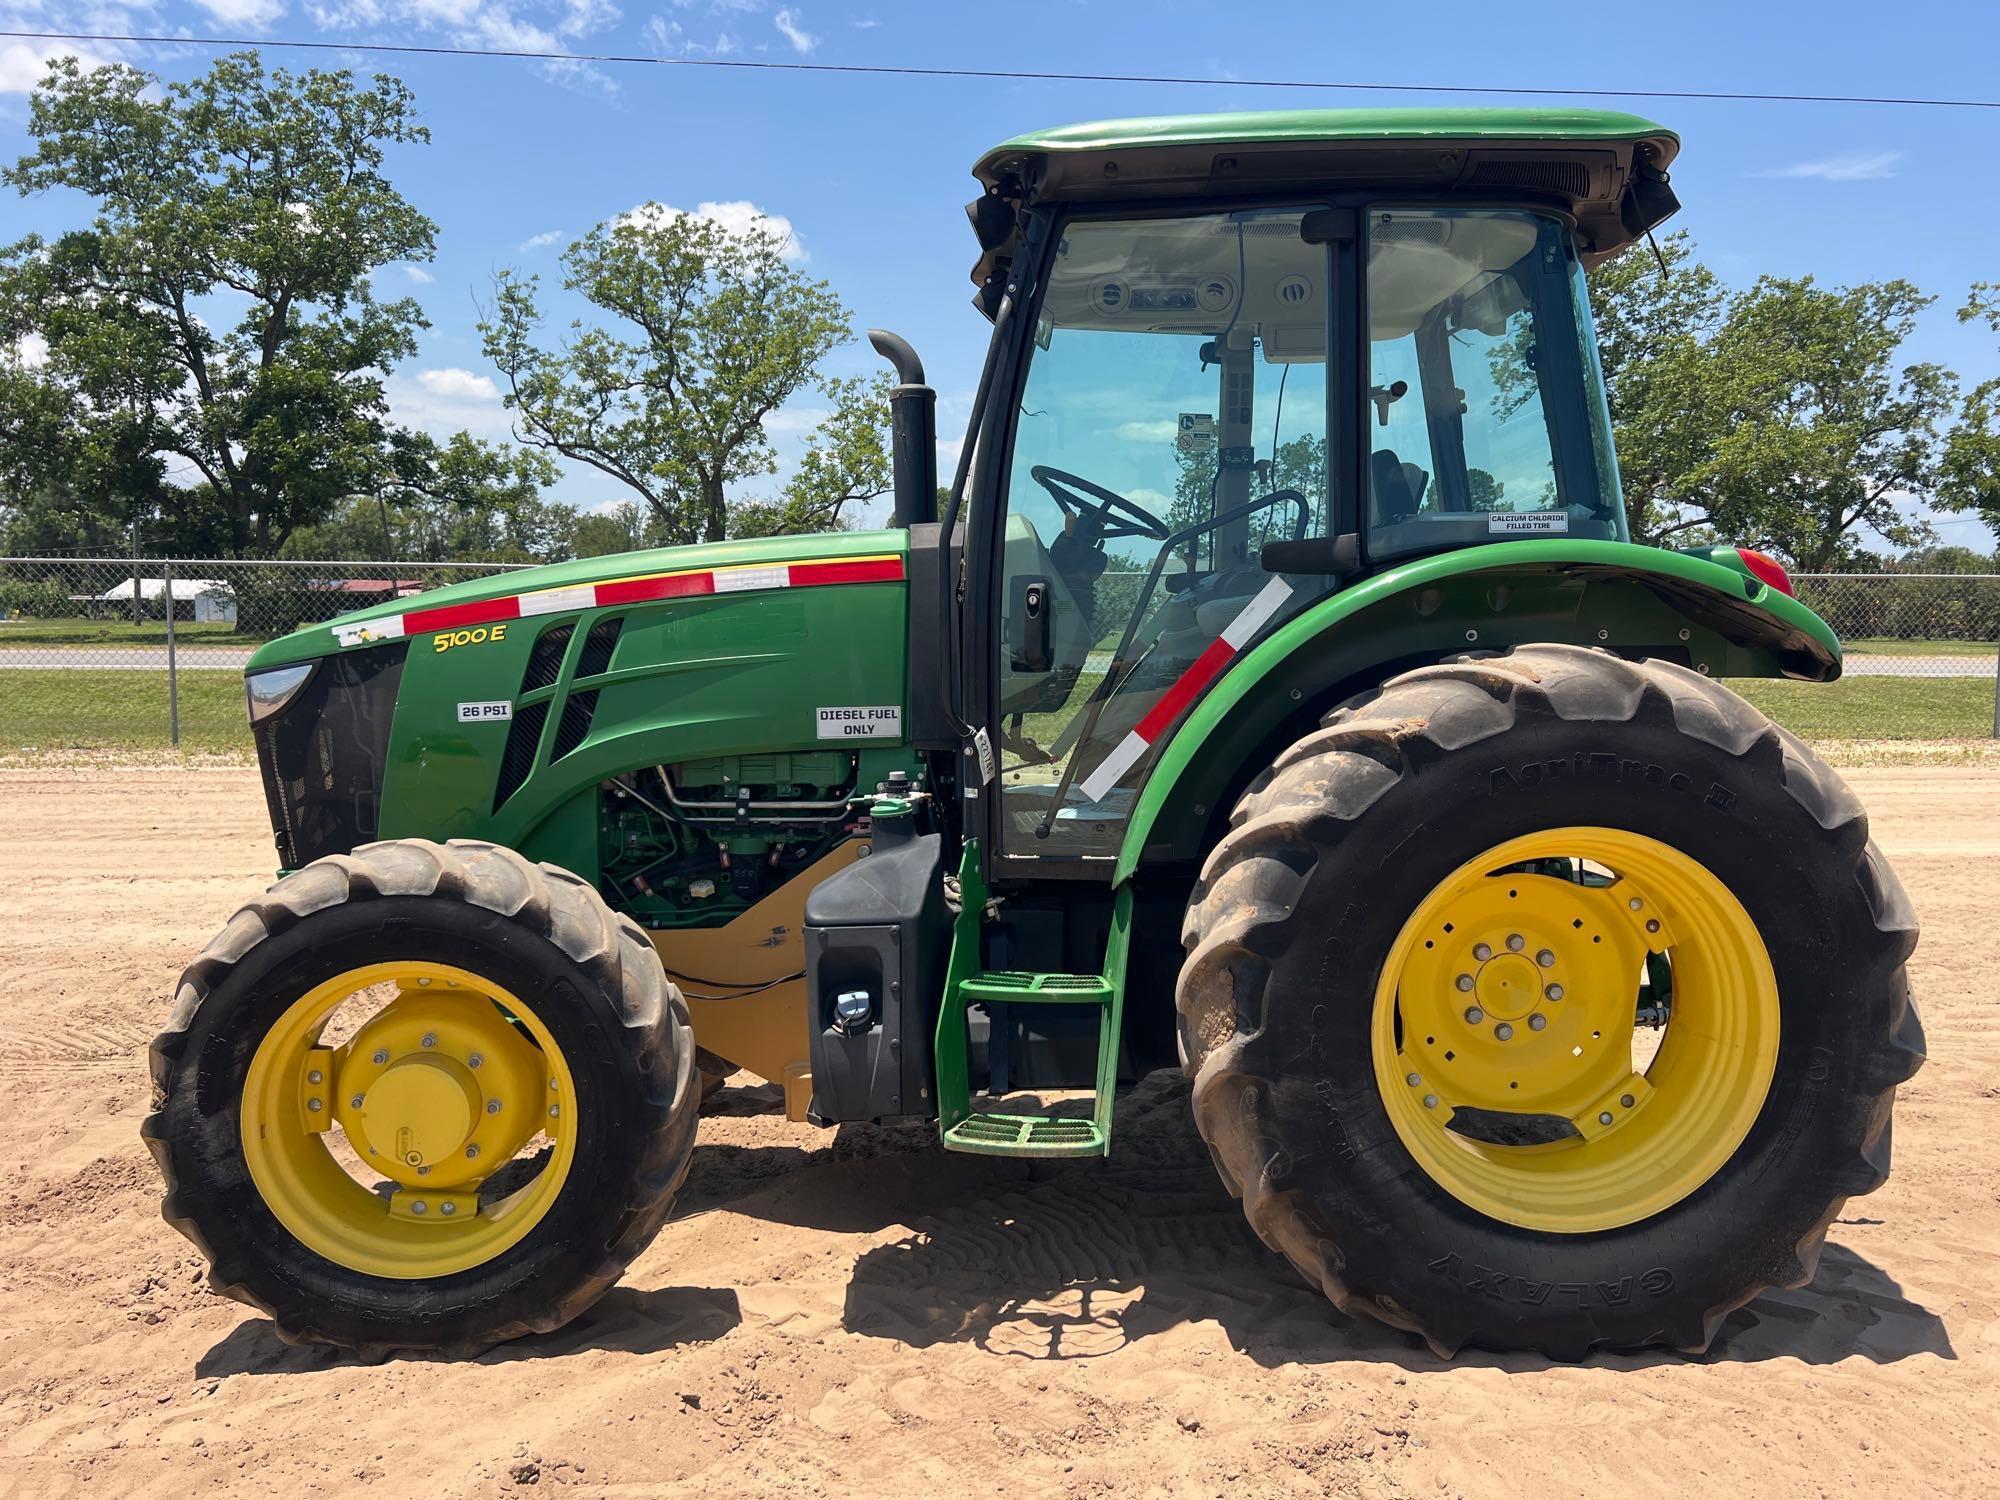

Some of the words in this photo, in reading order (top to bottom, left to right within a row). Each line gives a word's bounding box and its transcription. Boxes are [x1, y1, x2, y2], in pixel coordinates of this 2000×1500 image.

[462, 707, 480, 717] 26
[483, 705, 507, 716] PSI
[820, 710, 865, 720] DIESEL
[868, 709, 898, 719] FUEL
[844, 724, 875, 735] ONLY
[1427, 1250, 1676, 1307] GALAXY
